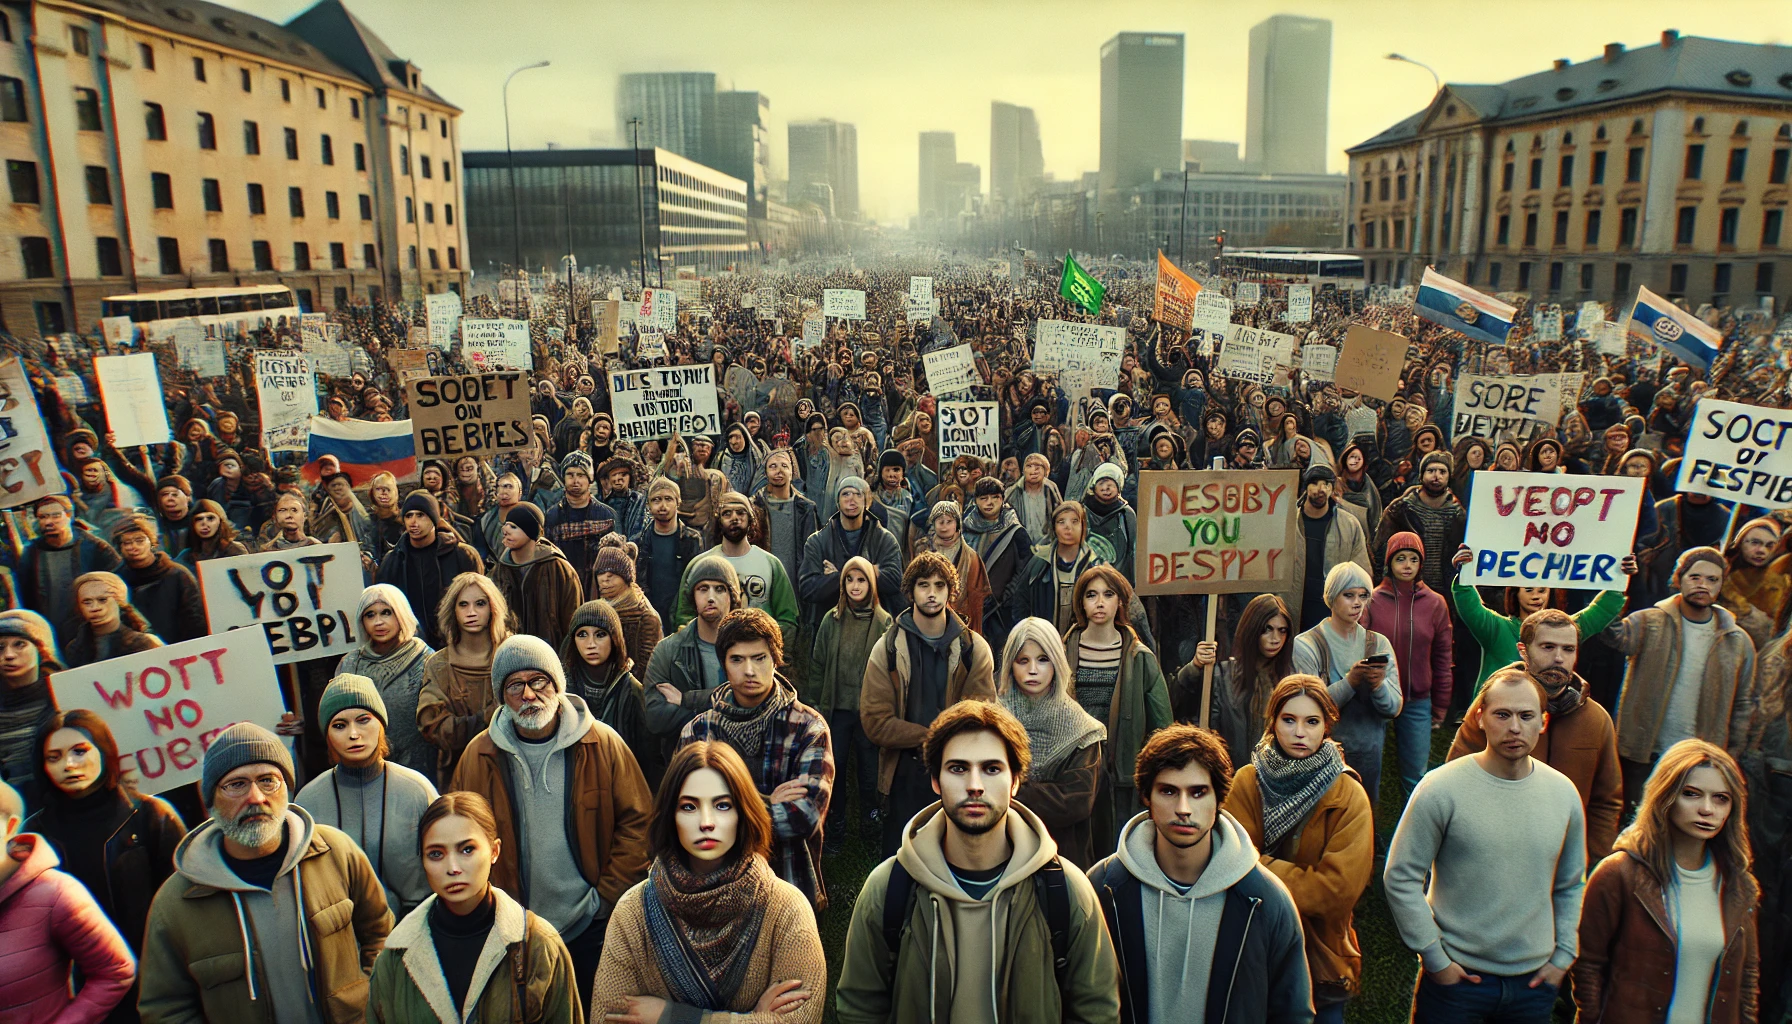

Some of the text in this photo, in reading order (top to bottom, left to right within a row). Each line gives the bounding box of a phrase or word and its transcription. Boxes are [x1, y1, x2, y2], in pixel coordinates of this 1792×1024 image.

[1182, 517, 1241, 547] YOU
[1523, 521, 1576, 547] NO
[93, 648, 228, 710] WOTT
[143, 698, 205, 736] NO
